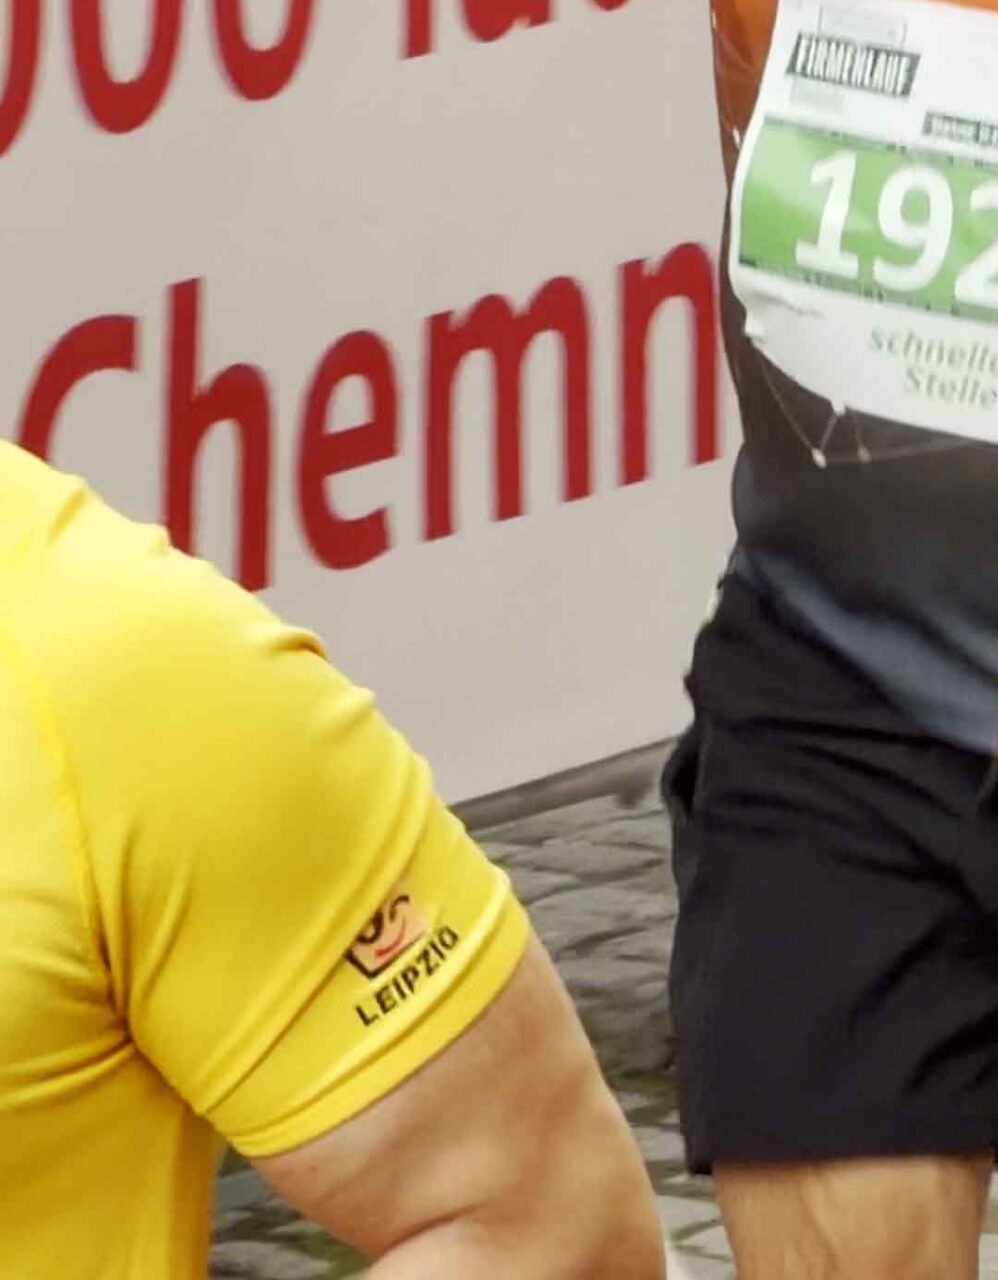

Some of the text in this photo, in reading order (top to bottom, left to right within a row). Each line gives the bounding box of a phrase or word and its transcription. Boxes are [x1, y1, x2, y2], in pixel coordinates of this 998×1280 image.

[794, 35, 912, 96] FIRMENLAUF
[16, 240, 722, 592] Chemn
[355, 926, 459, 1027] LEIPZIG
